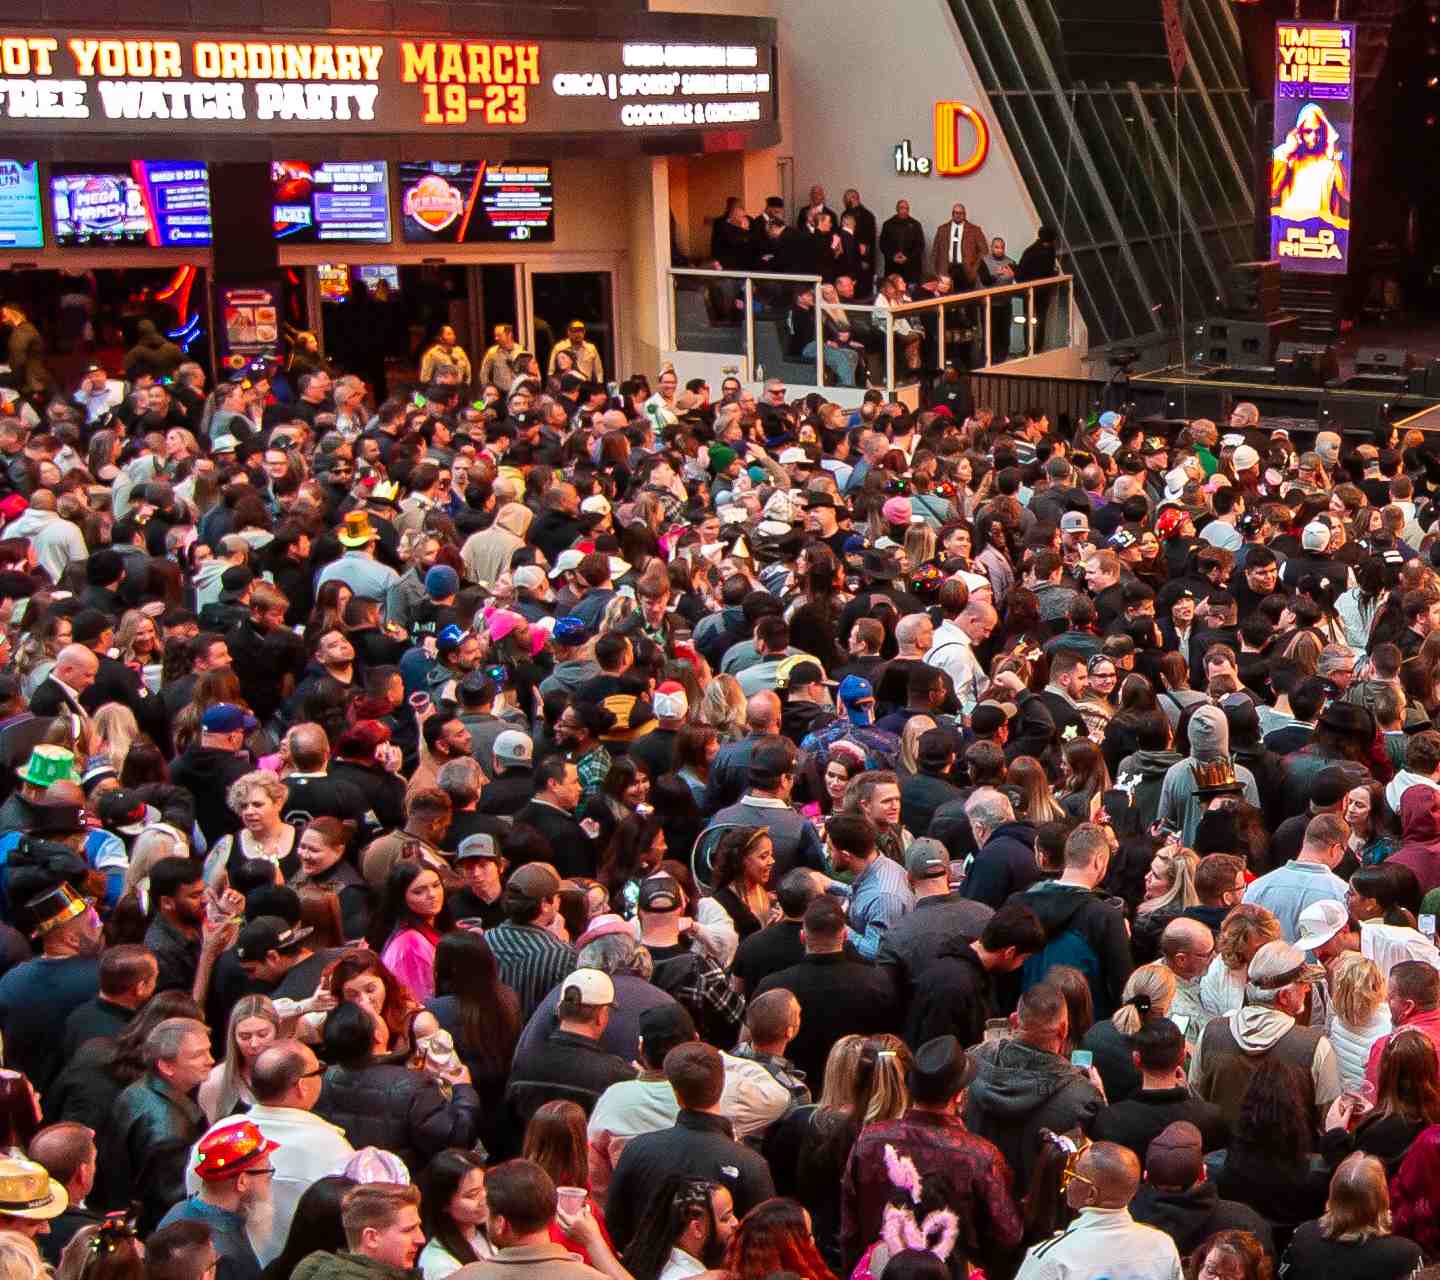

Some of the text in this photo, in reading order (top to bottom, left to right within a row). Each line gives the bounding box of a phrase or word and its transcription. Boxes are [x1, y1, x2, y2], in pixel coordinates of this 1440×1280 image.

[1278, 27, 1341, 48] TIME
[1279, 46, 1351, 66] YOUR
[68, 39, 182, 78] YOUR
[192, 42, 383, 80] ORDINARY
[401, 41, 541, 85] MARCH
[1279, 64, 1351, 84] LIFE
[98, 80, 246, 120] WATCH
[255, 83, 379, 121] PARTY
[422, 83, 528, 125] 19-23
[895, 101, 991, 177] the D
